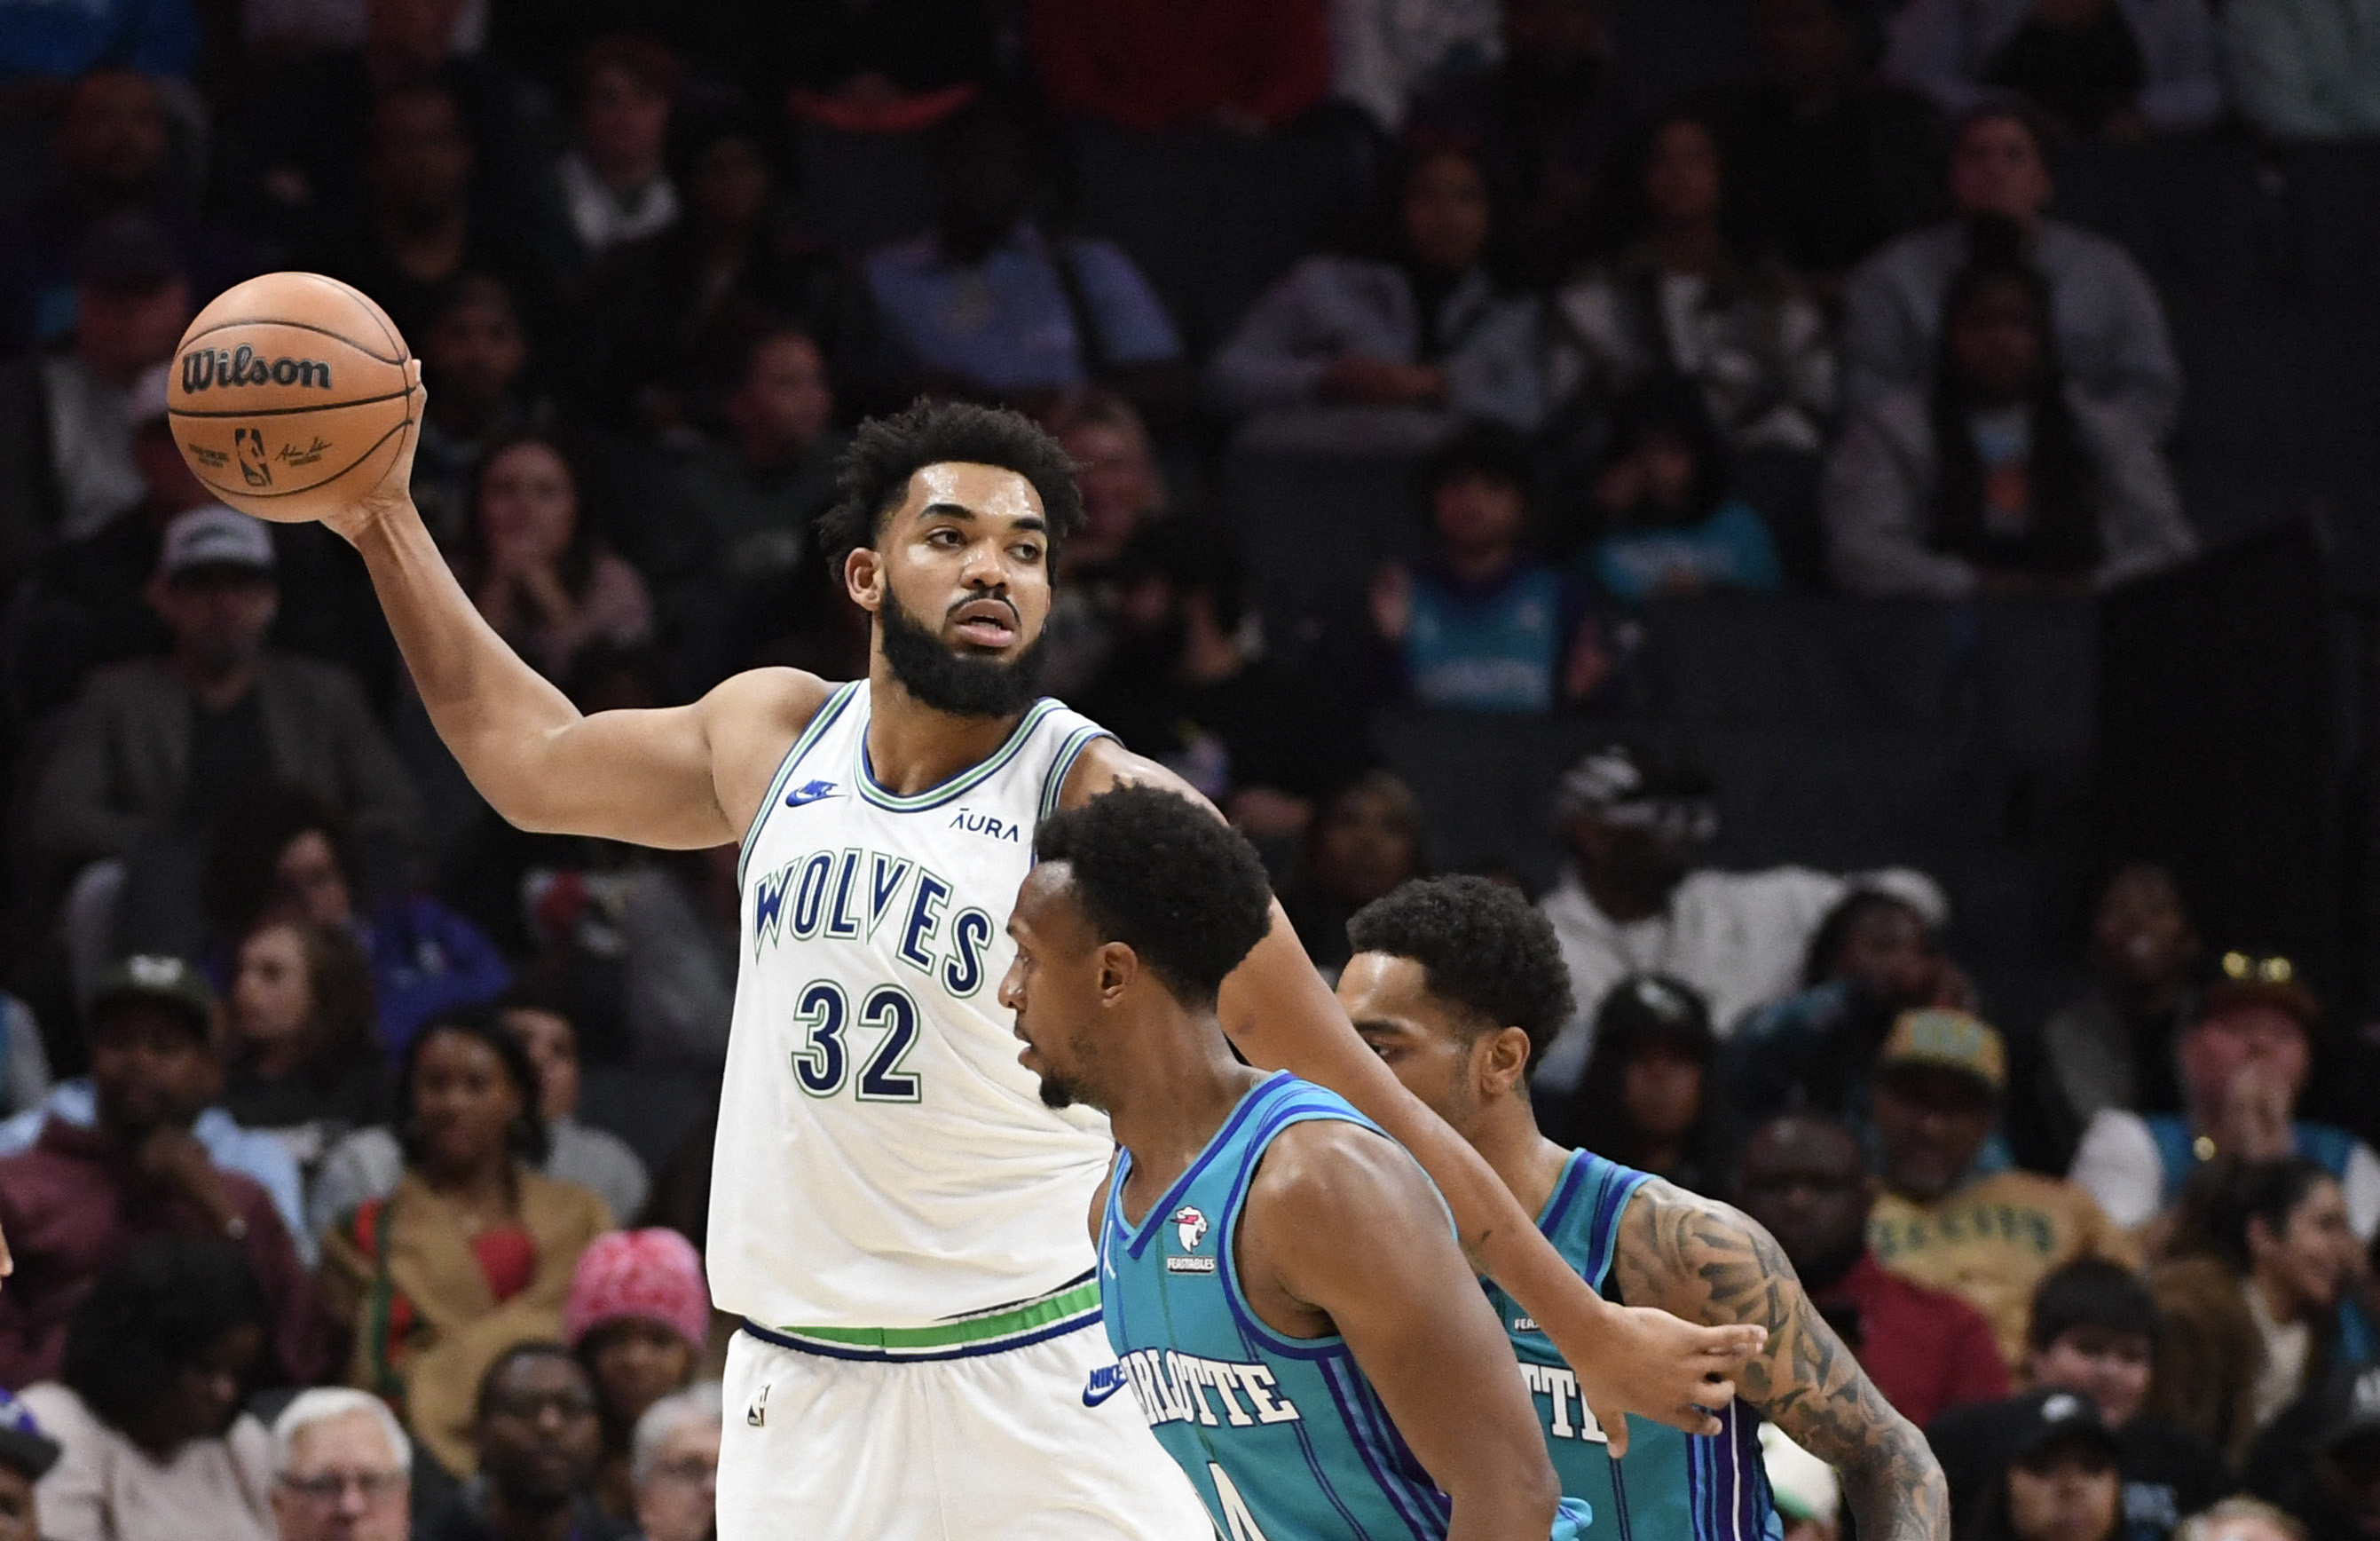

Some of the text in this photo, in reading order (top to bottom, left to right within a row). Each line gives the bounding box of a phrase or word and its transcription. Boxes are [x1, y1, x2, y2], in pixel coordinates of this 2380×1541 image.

[182, 342, 333, 394] Wilson
[754, 847, 994, 998] WOLVES
[792, 979, 922, 1102] 32
[1514, 1318, 1540, 1331] FEA
